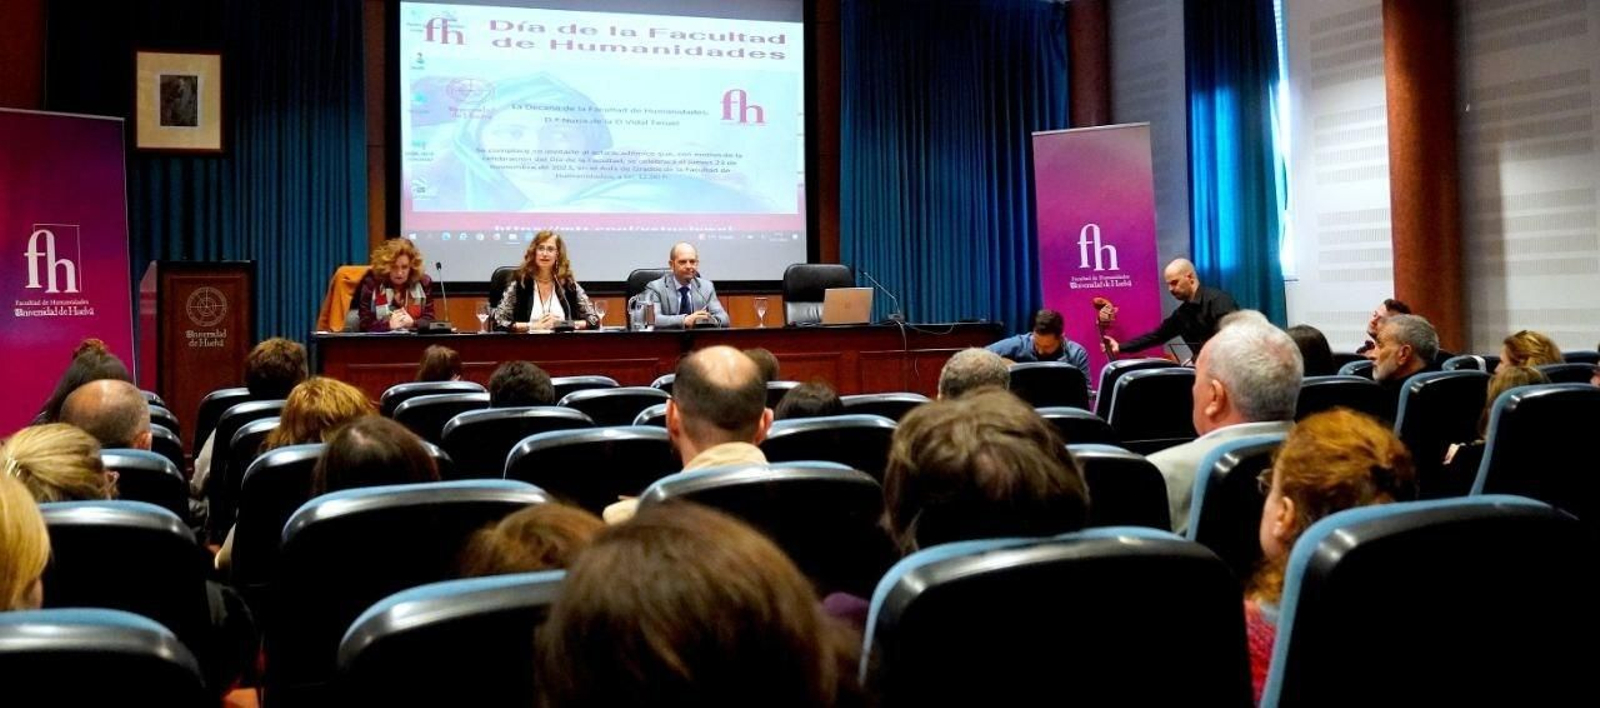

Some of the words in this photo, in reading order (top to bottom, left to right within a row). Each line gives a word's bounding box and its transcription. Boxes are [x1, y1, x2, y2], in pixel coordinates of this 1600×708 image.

[490, 20, 546, 33] Día
[557, 24, 598, 35] de
[609, 26, 637, 37] la
[649, 28, 786, 44] Facultad
[491, 37, 535, 49] de
[550, 39, 786, 60] Humanidades
[720, 89, 765, 123] fh
[24, 229, 79, 293] fh
[1077, 223, 1120, 271] fh
[14, 306, 58, 317] Universidad
[59, 306, 68, 316] de
[68, 305, 95, 316] Huelva
